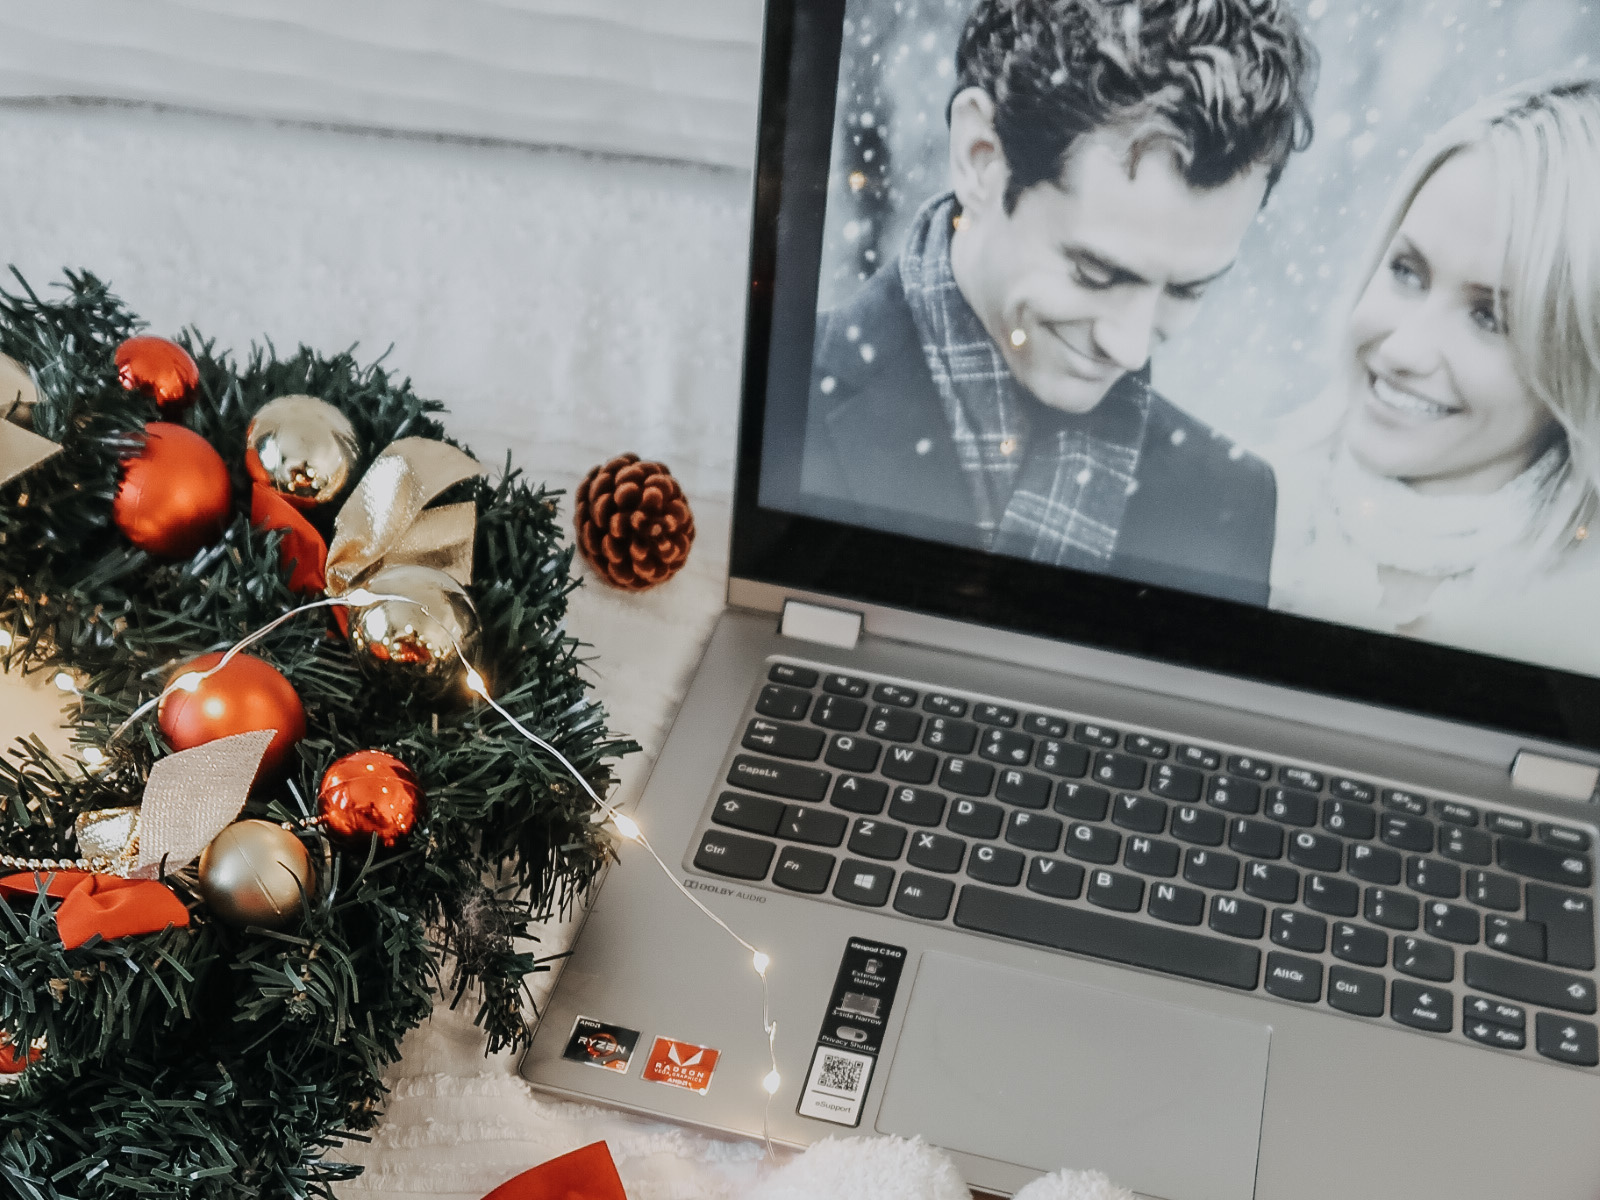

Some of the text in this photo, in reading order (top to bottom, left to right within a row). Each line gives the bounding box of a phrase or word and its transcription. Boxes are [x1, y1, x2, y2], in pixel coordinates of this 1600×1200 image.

[822, 709, 830, 720] 1
[874, 720, 887, 732] 2
[836, 736, 853, 751] Q
[930, 731, 943, 743] 3
[894, 747, 914, 762] W
[987, 743, 999, 755] 4
[949, 758, 964, 773] E
[1043, 754, 1056, 767] 5
[737, 763, 779, 778] CapsLk
[1099, 766, 1113, 779] 6
[842, 777, 856, 791] A
[1006, 771, 1022, 785] R
[1158, 778, 1170, 790] 7
[900, 788, 915, 802] S
[1065, 783, 1079, 797] T
[1214, 790, 1228, 803] 8
[957, 800, 974, 814] D
[1123, 795, 1138, 809] Y
[1015, 812, 1030, 826] F
[1180, 807, 1196, 822] U
[859, 821, 875, 835] Z
[1075, 825, 1092, 841] G
[1238, 820, 1246, 833] I
[918, 833, 934, 849] X
[1133, 838, 1150, 853] H
[1296, 833, 1315, 848] O
[704, 843, 726, 855] Ctrl
[977, 846, 994, 861] C
[1355, 844, 1370, 859] P
[1193, 851, 1207, 865] J
[783, 860, 800, 871] Fn
[1039, 859, 1054, 873] V
[1252, 863, 1267, 879] K
[1096, 871, 1112, 887] B
[1312, 875, 1325, 892] L
[700, 884, 767, 904] DOLBY AUDIO
[904, 886, 921, 898] Alt
[1157, 884, 1174, 901] N
[1218, 897, 1238, 914] M
[1273, 967, 1304, 982] AltGr
[1335, 980, 1358, 994] Ctrl
[577, 1036, 627, 1055] RYZEN
[821, 1035, 877, 1053] Privacy Shutter
[655, 1061, 705, 1079] RADEON
[815, 1101, 852, 1113] eSupport
